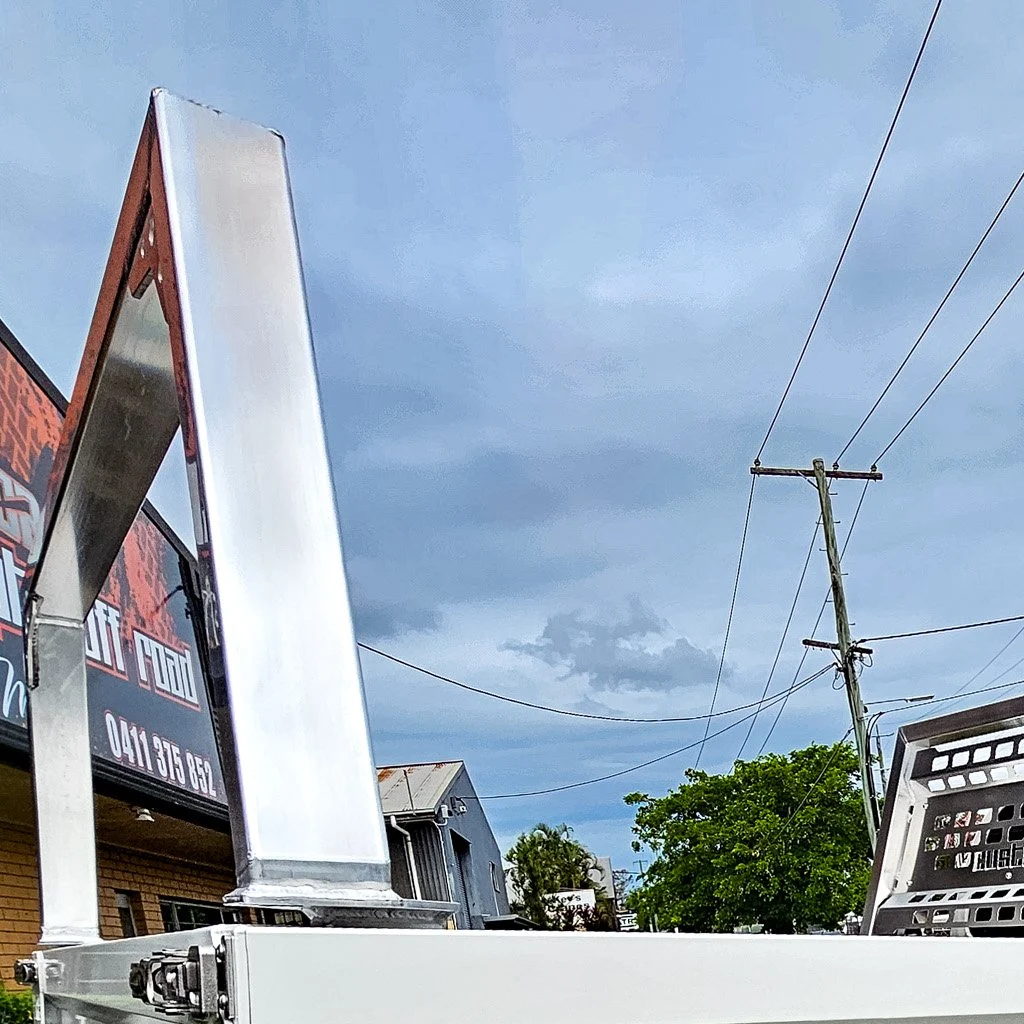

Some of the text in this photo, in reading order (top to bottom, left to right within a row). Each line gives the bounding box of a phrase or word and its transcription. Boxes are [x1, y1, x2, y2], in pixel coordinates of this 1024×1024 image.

[133, 630, 198, 704] road
[105, 712, 216, 797] 0411 375 852
